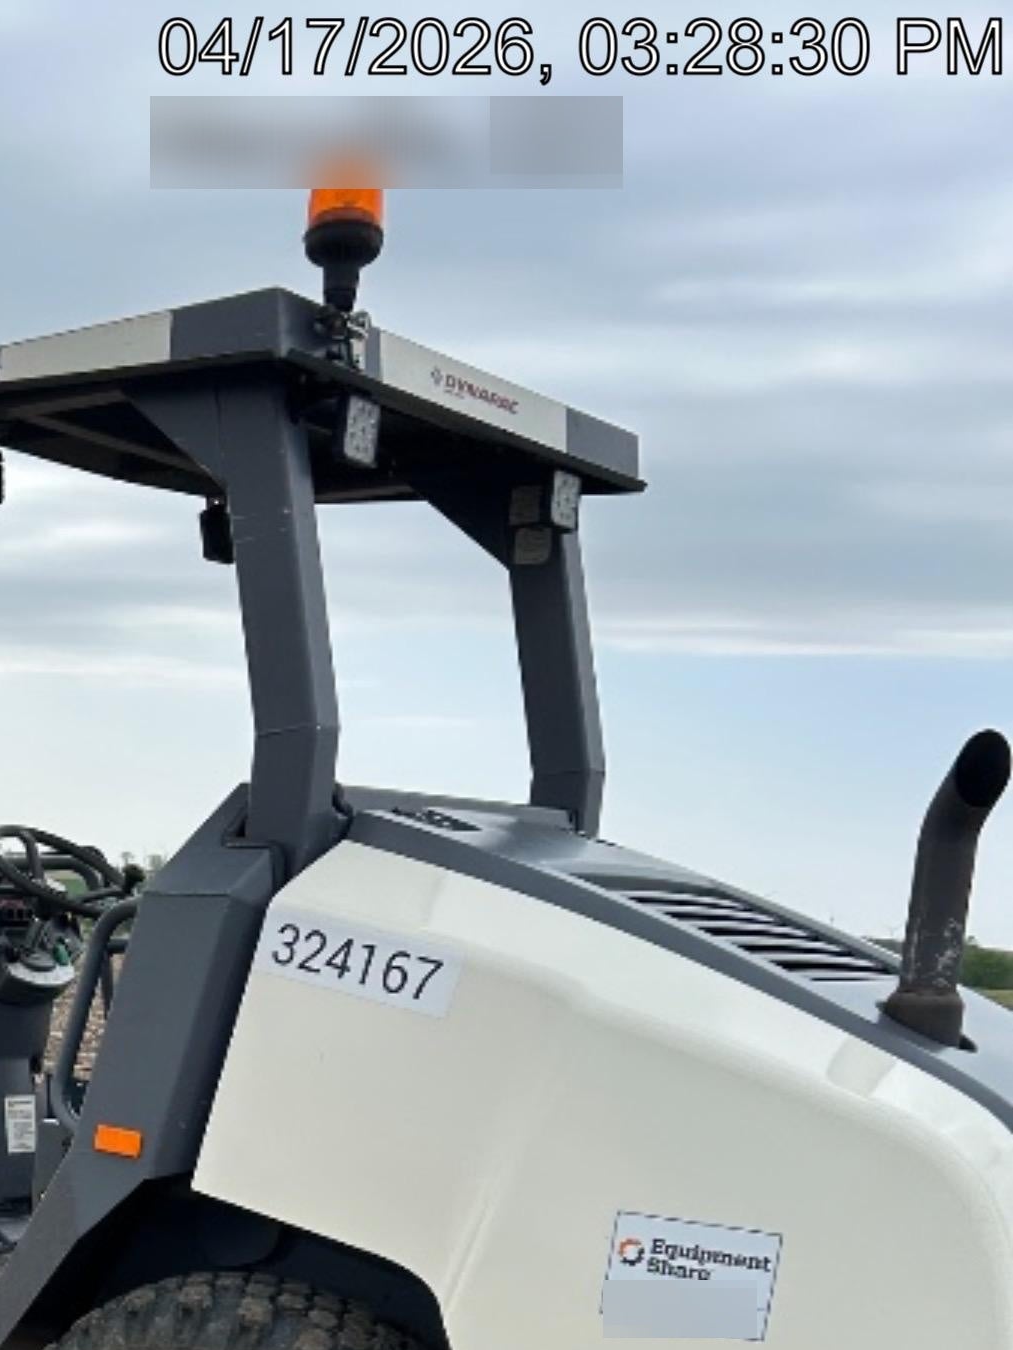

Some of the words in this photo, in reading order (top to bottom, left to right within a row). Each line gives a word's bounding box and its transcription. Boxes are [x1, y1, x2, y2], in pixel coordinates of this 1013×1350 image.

[272, 923, 444, 1000] 324167
[646, 1256, 712, 1281] Share
[650, 1238, 771, 1273] Equipment
